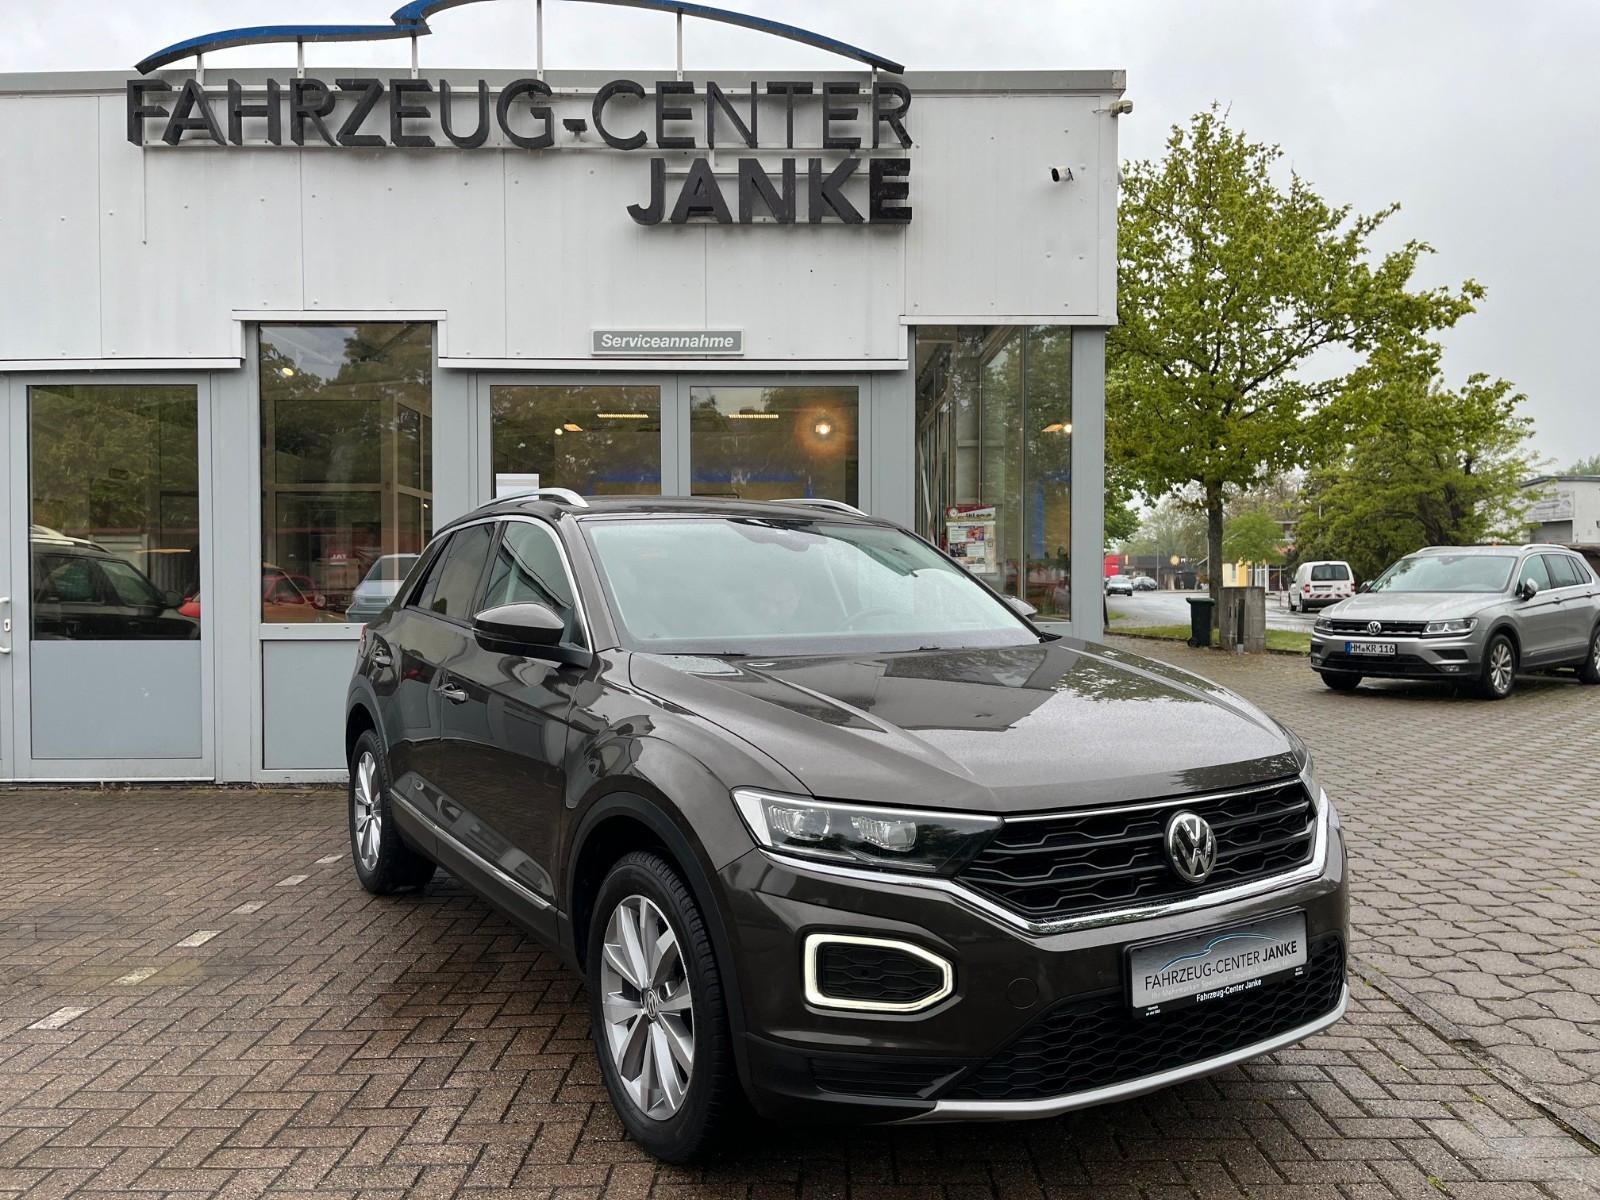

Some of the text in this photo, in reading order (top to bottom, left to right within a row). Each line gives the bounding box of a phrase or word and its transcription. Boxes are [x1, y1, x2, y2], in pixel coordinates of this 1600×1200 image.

[127, 78, 912, 150] FAHRZEUG-CENTER
[626, 157, 912, 227] JANKE
[600, 333, 735, 349] Serviceannahme
[1379, 645, 1395, 654] 116
[1166, 811, 1216, 882] VW
[1145, 950, 1260, 990] FAHRZEUG-CENTER
[1262, 940, 1297, 962] JANKE
[1196, 978, 1262, 1003] Fahrzeug-Center Janke
